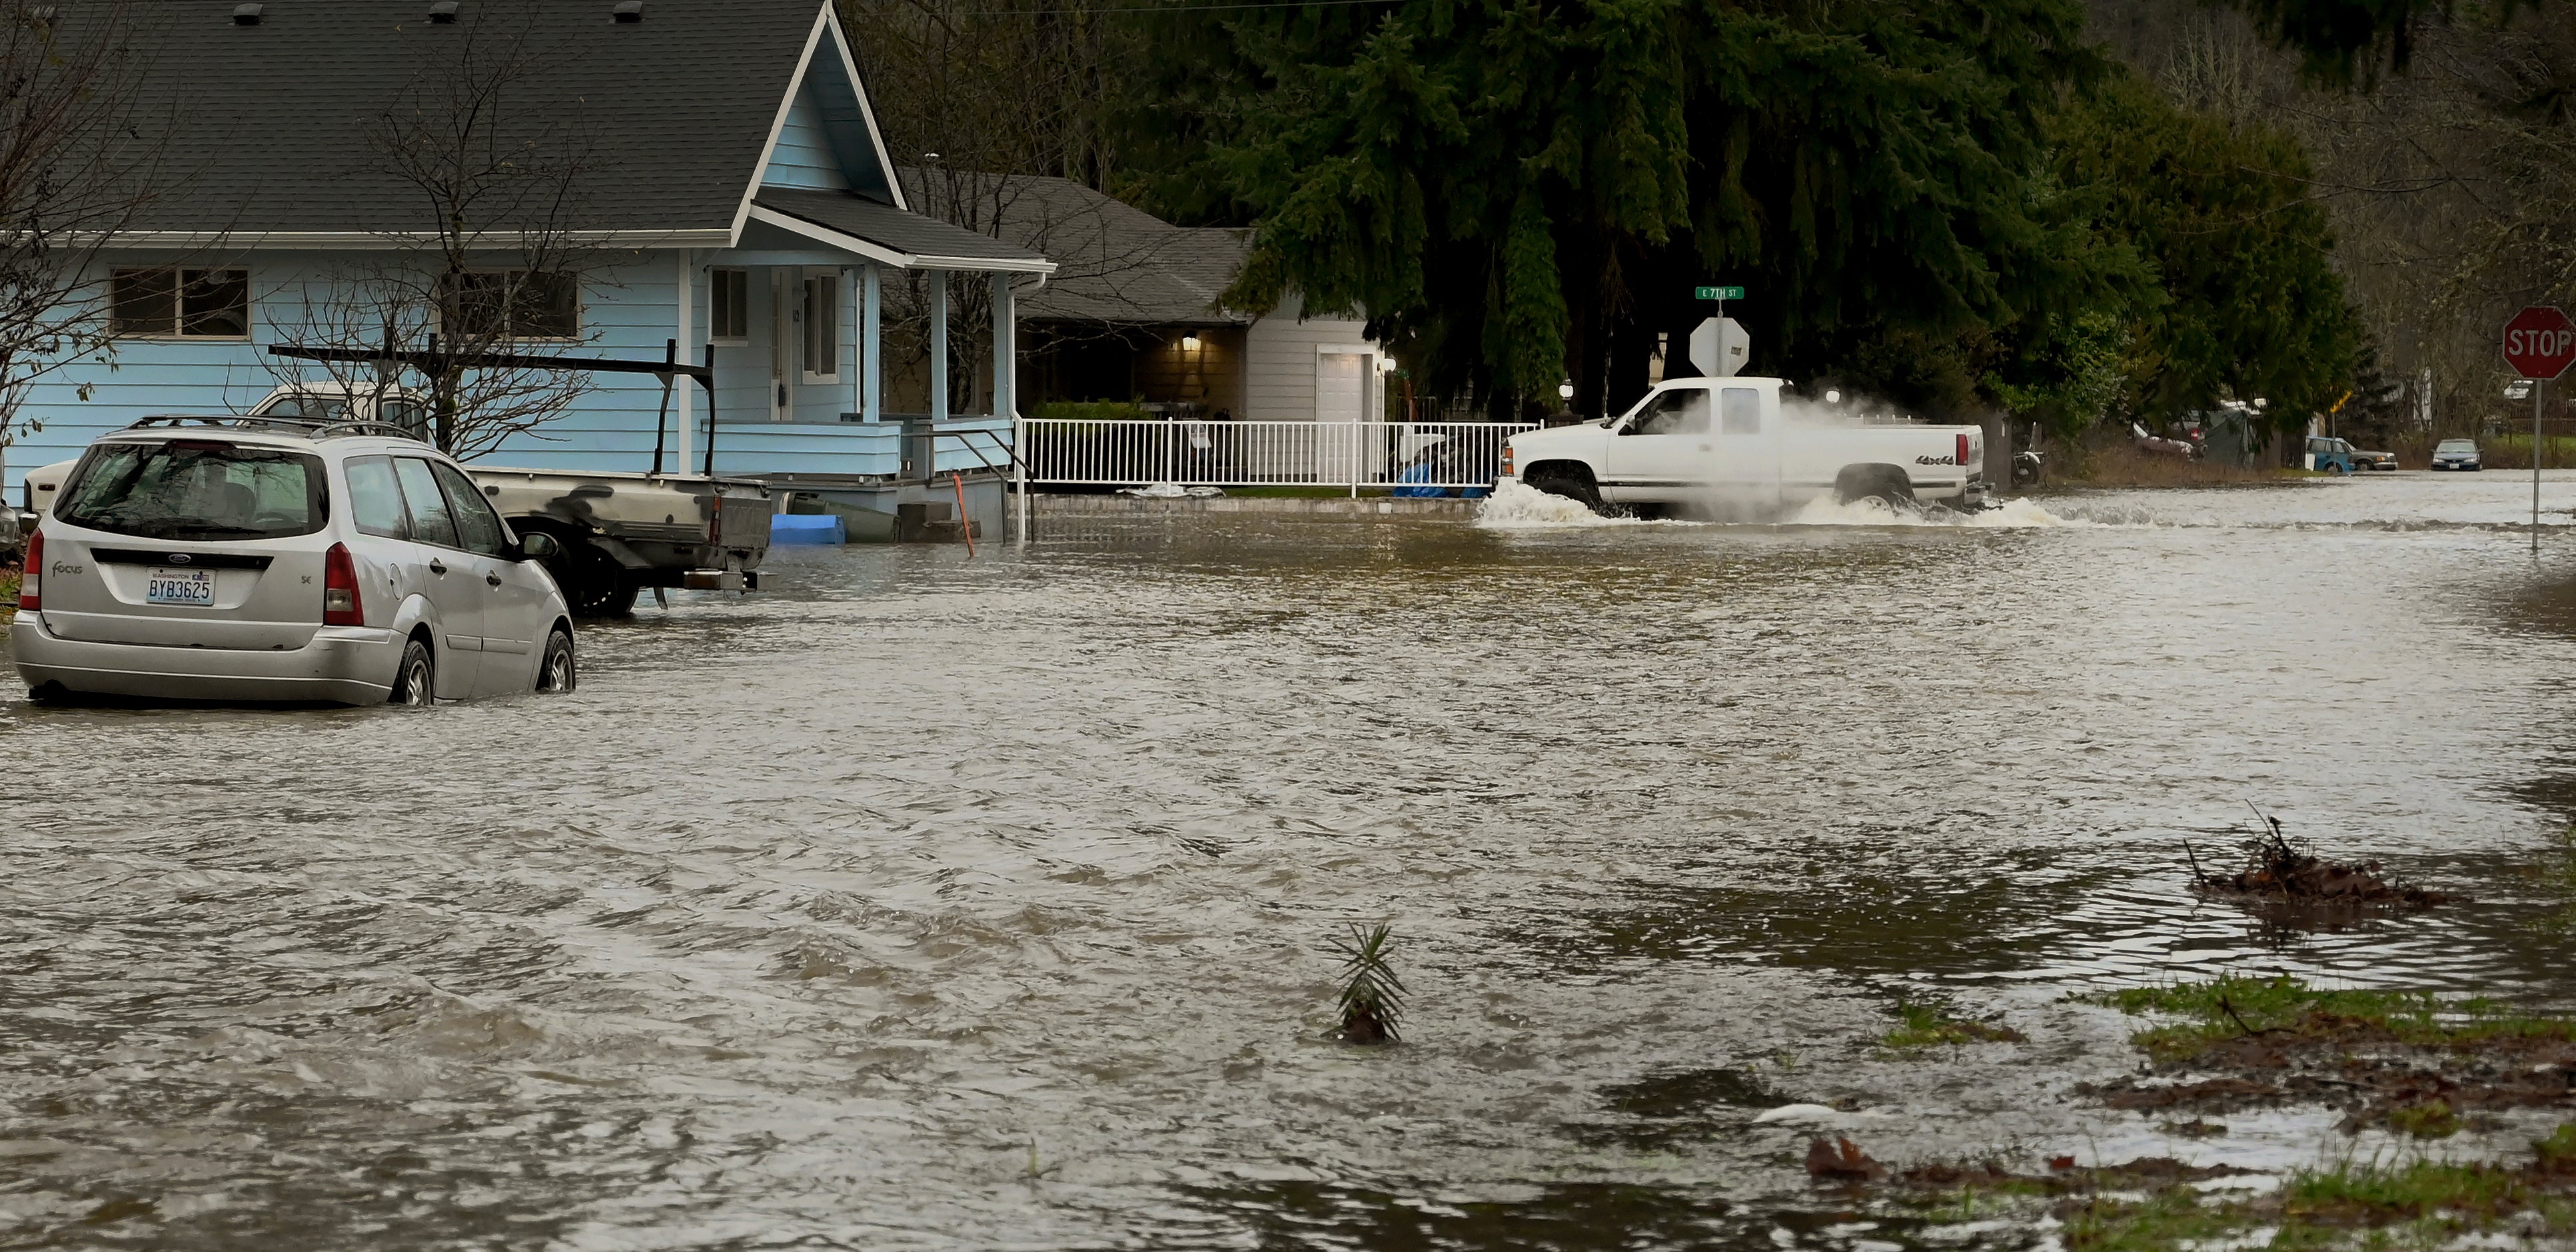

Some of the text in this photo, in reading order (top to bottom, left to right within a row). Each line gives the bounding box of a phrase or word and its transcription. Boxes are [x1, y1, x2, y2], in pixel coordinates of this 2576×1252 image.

[1710, 289, 1726, 298] 7TH
[2509, 329, 2572, 356] STOP
[1916, 455, 1954, 465] 4x4
[301, 576, 312, 584] SE
[149, 580, 210, 599] BYB3625
